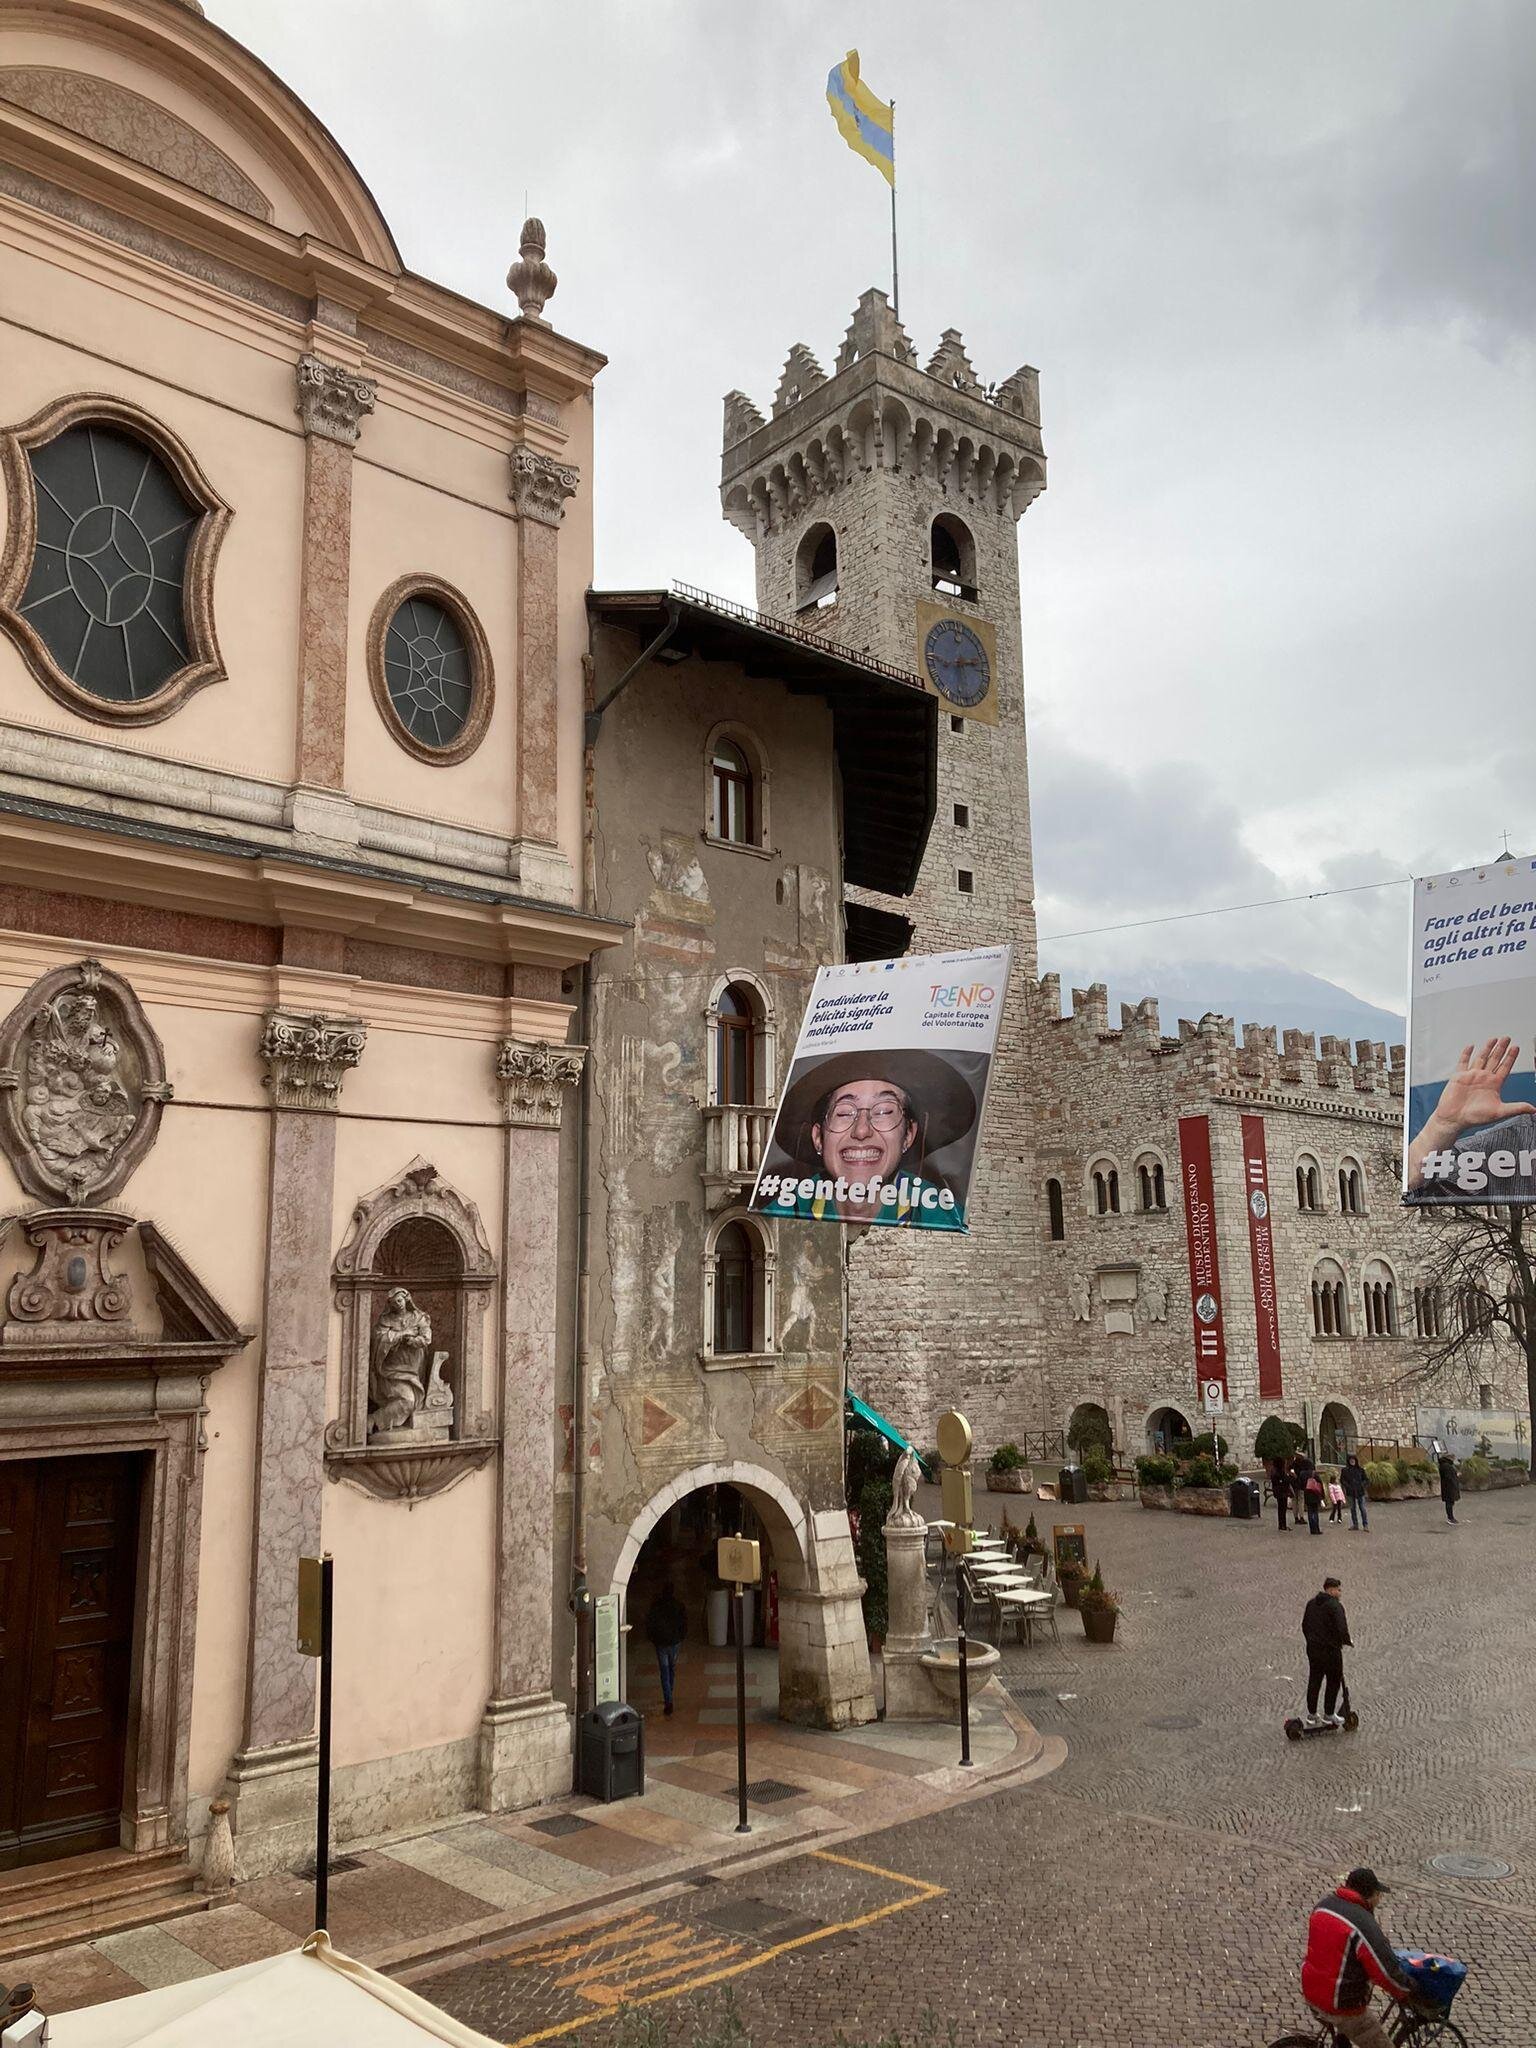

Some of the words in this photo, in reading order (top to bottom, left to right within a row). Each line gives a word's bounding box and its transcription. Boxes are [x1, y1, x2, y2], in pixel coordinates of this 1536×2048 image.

[1424, 915, 1465, 932] Fare
[1467, 905, 1498, 923] del
[1424, 930, 1460, 952] agli
[1462, 922, 1504, 942] altri
[1505, 920, 1525, 937] fa
[1423, 947, 1480, 968] anche
[1481, 945, 1494, 957] a
[1497, 939, 1528, 953] me
[815, 994, 876, 1010] Condividere
[877, 990, 890, 1002] la
[930, 983, 996, 1008] TRENTO
[806, 1020, 874, 1038] moltiplicarla
[809, 1006, 847, 1026] felicità
[847, 1004, 894, 1022] significa
[921, 1019, 934, 1027] del
[935, 1019, 985, 1028] Volontariato
[924, 1011, 955, 1021] Capitale
[956, 1011, 990, 1020] Europea
[758, 1174, 955, 1210] #gentefelice
[1187, 1163, 1200, 1237] DIOCESANO
[1200, 1202, 1212, 1286] TRIDENTINO
[1260, 1225, 1270, 1272] MUSEO
[1193, 1239, 1206, 1286] MUSEO
[1255, 1225, 1268, 1309] TRIDENTINO
[1264, 1273, 1277, 1350] DIOCESANO
